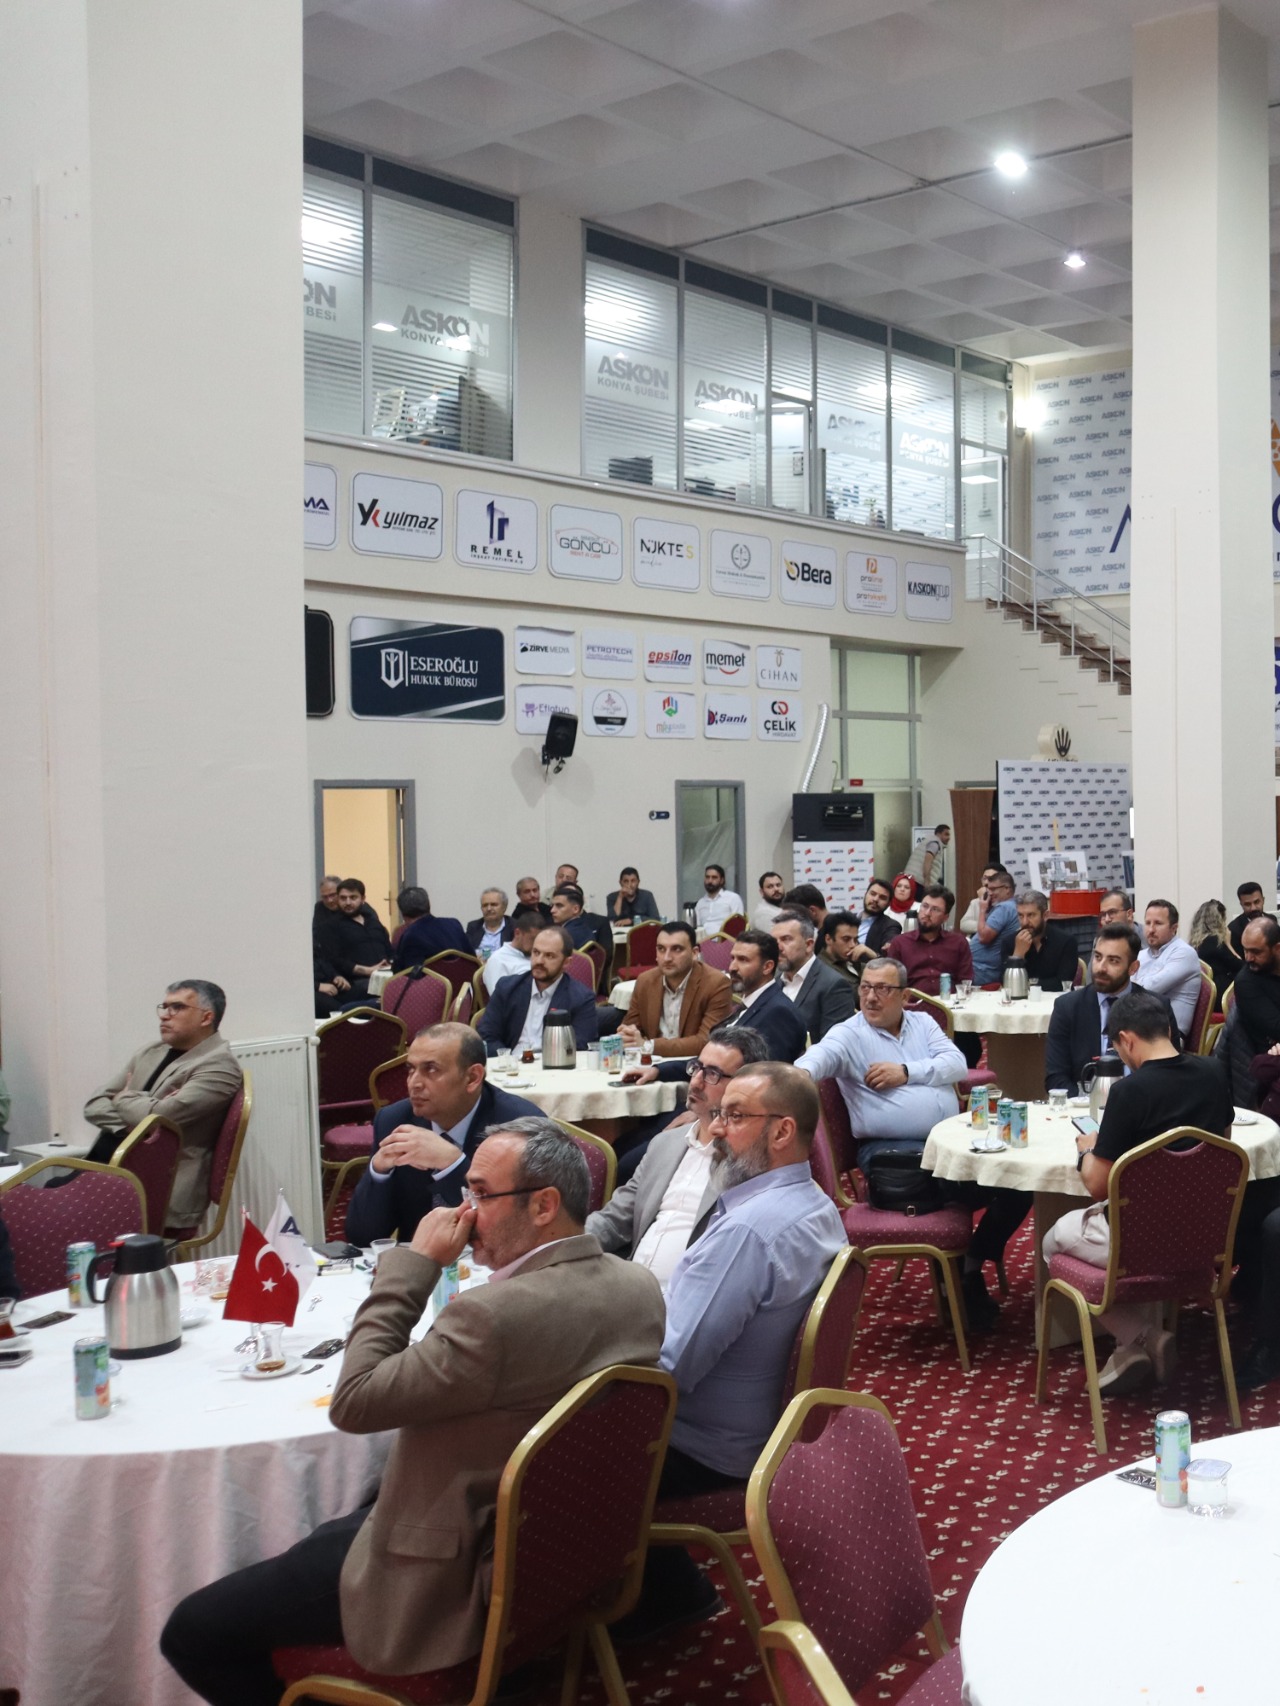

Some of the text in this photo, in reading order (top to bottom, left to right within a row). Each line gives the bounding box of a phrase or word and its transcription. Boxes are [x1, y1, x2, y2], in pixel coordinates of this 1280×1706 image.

[401, 304, 490, 346] ASKON
[597, 355, 670, 390] ASKON
[597, 376, 632, 393] KONYA
[382, 511, 439, 530] yılmaz
[470, 544, 523, 559] REMEL
[801, 562, 832, 586] Bera
[410, 656, 479, 675] ESEROĞLU
[705, 652, 746, 667] memet
[410, 674, 478, 688] HUKUK BÜROSU
[760, 668, 798, 682] CİHAN
[763, 717, 797, 734] ÇELİK
